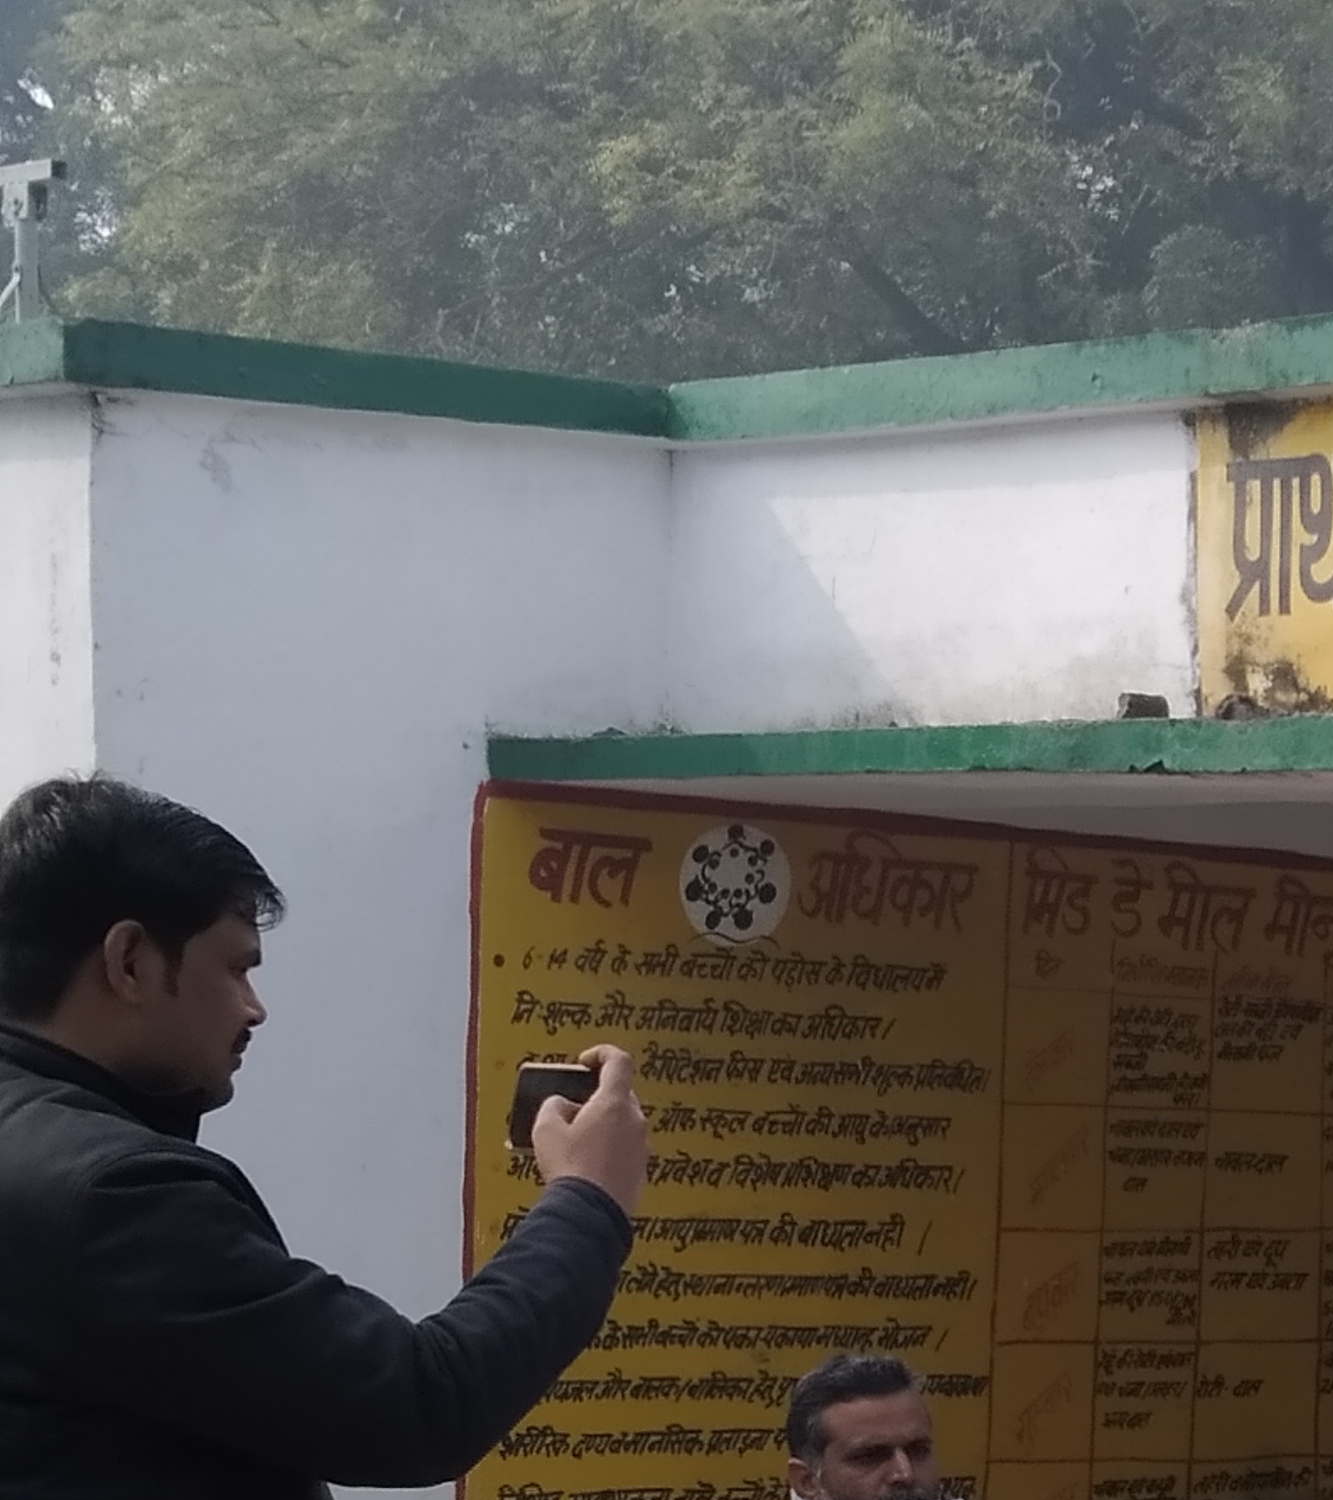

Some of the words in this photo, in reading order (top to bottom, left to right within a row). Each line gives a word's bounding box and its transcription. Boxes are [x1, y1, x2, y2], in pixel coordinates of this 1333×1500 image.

[529, 826, 652, 908] बाल
[799, 828, 980, 933] अधिकार
[1109, 857, 1154, 938] डे
[1157, 860, 1258, 955] मील
[595, 988, 636, 1031] और
